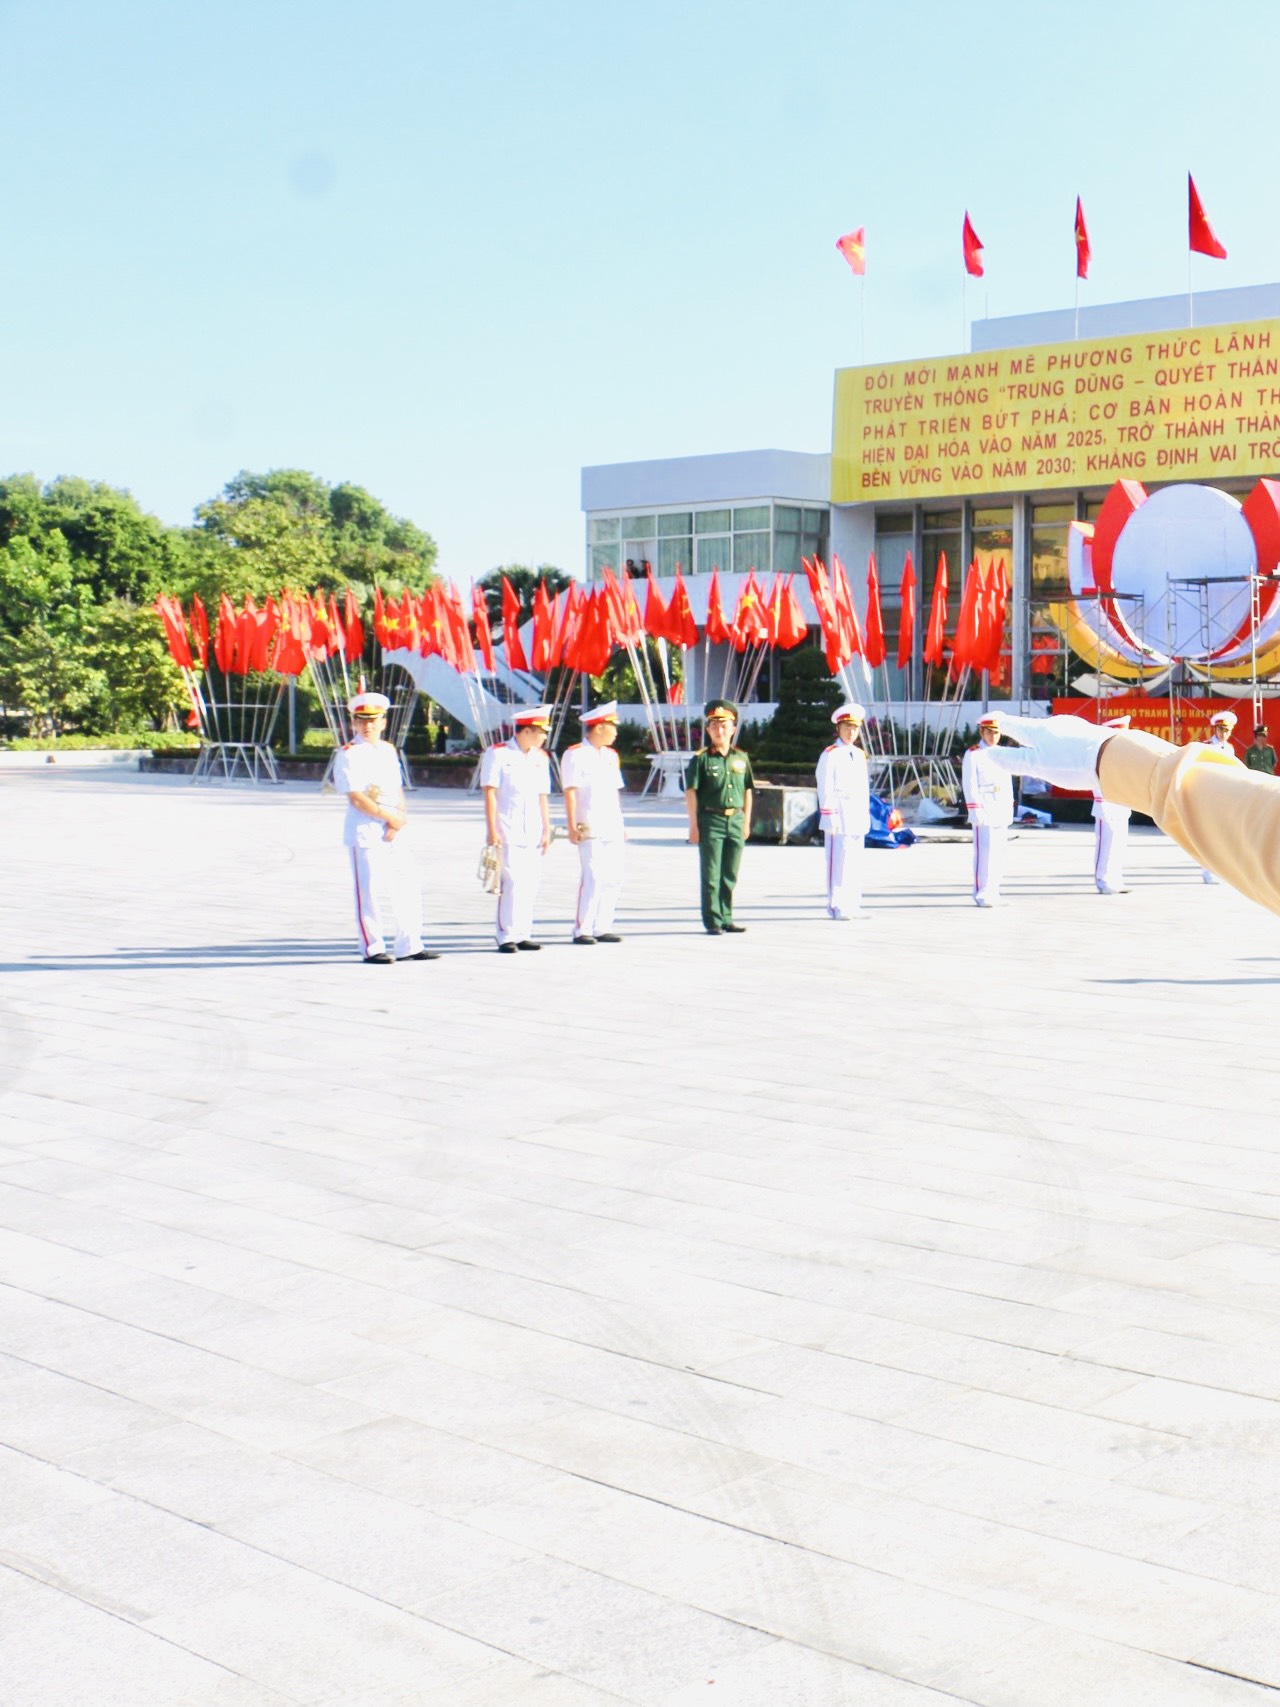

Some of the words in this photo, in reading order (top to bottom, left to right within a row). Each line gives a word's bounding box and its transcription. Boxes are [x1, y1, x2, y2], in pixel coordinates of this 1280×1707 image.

[947, 360, 999, 383] MẠNH
[1047, 347, 1133, 371] PHƯƠNG
[1215, 331, 1271, 352] LÃNH
[1075, 374, 1124, 395] DŨNG
[862, 446, 896, 467] HIỆN
[904, 442, 930, 462] ĐẠI
[938, 435, 970, 457] HÓA
[979, 432, 1013, 454] VÀO
[1021, 431, 1056, 450] NĂM
[1164, 414, 1225, 439] THÀNH
[863, 419, 908, 441] PHÁT
[1089, 399, 1119, 420] CƠ
[1184, 388, 1243, 411] HOÀN
[952, 459, 984, 481] VÀO
[992, 459, 1027, 477] NĂM
[1157, 446, 1199, 471] ĐỊNH
[1210, 441, 1238, 461] VAI
